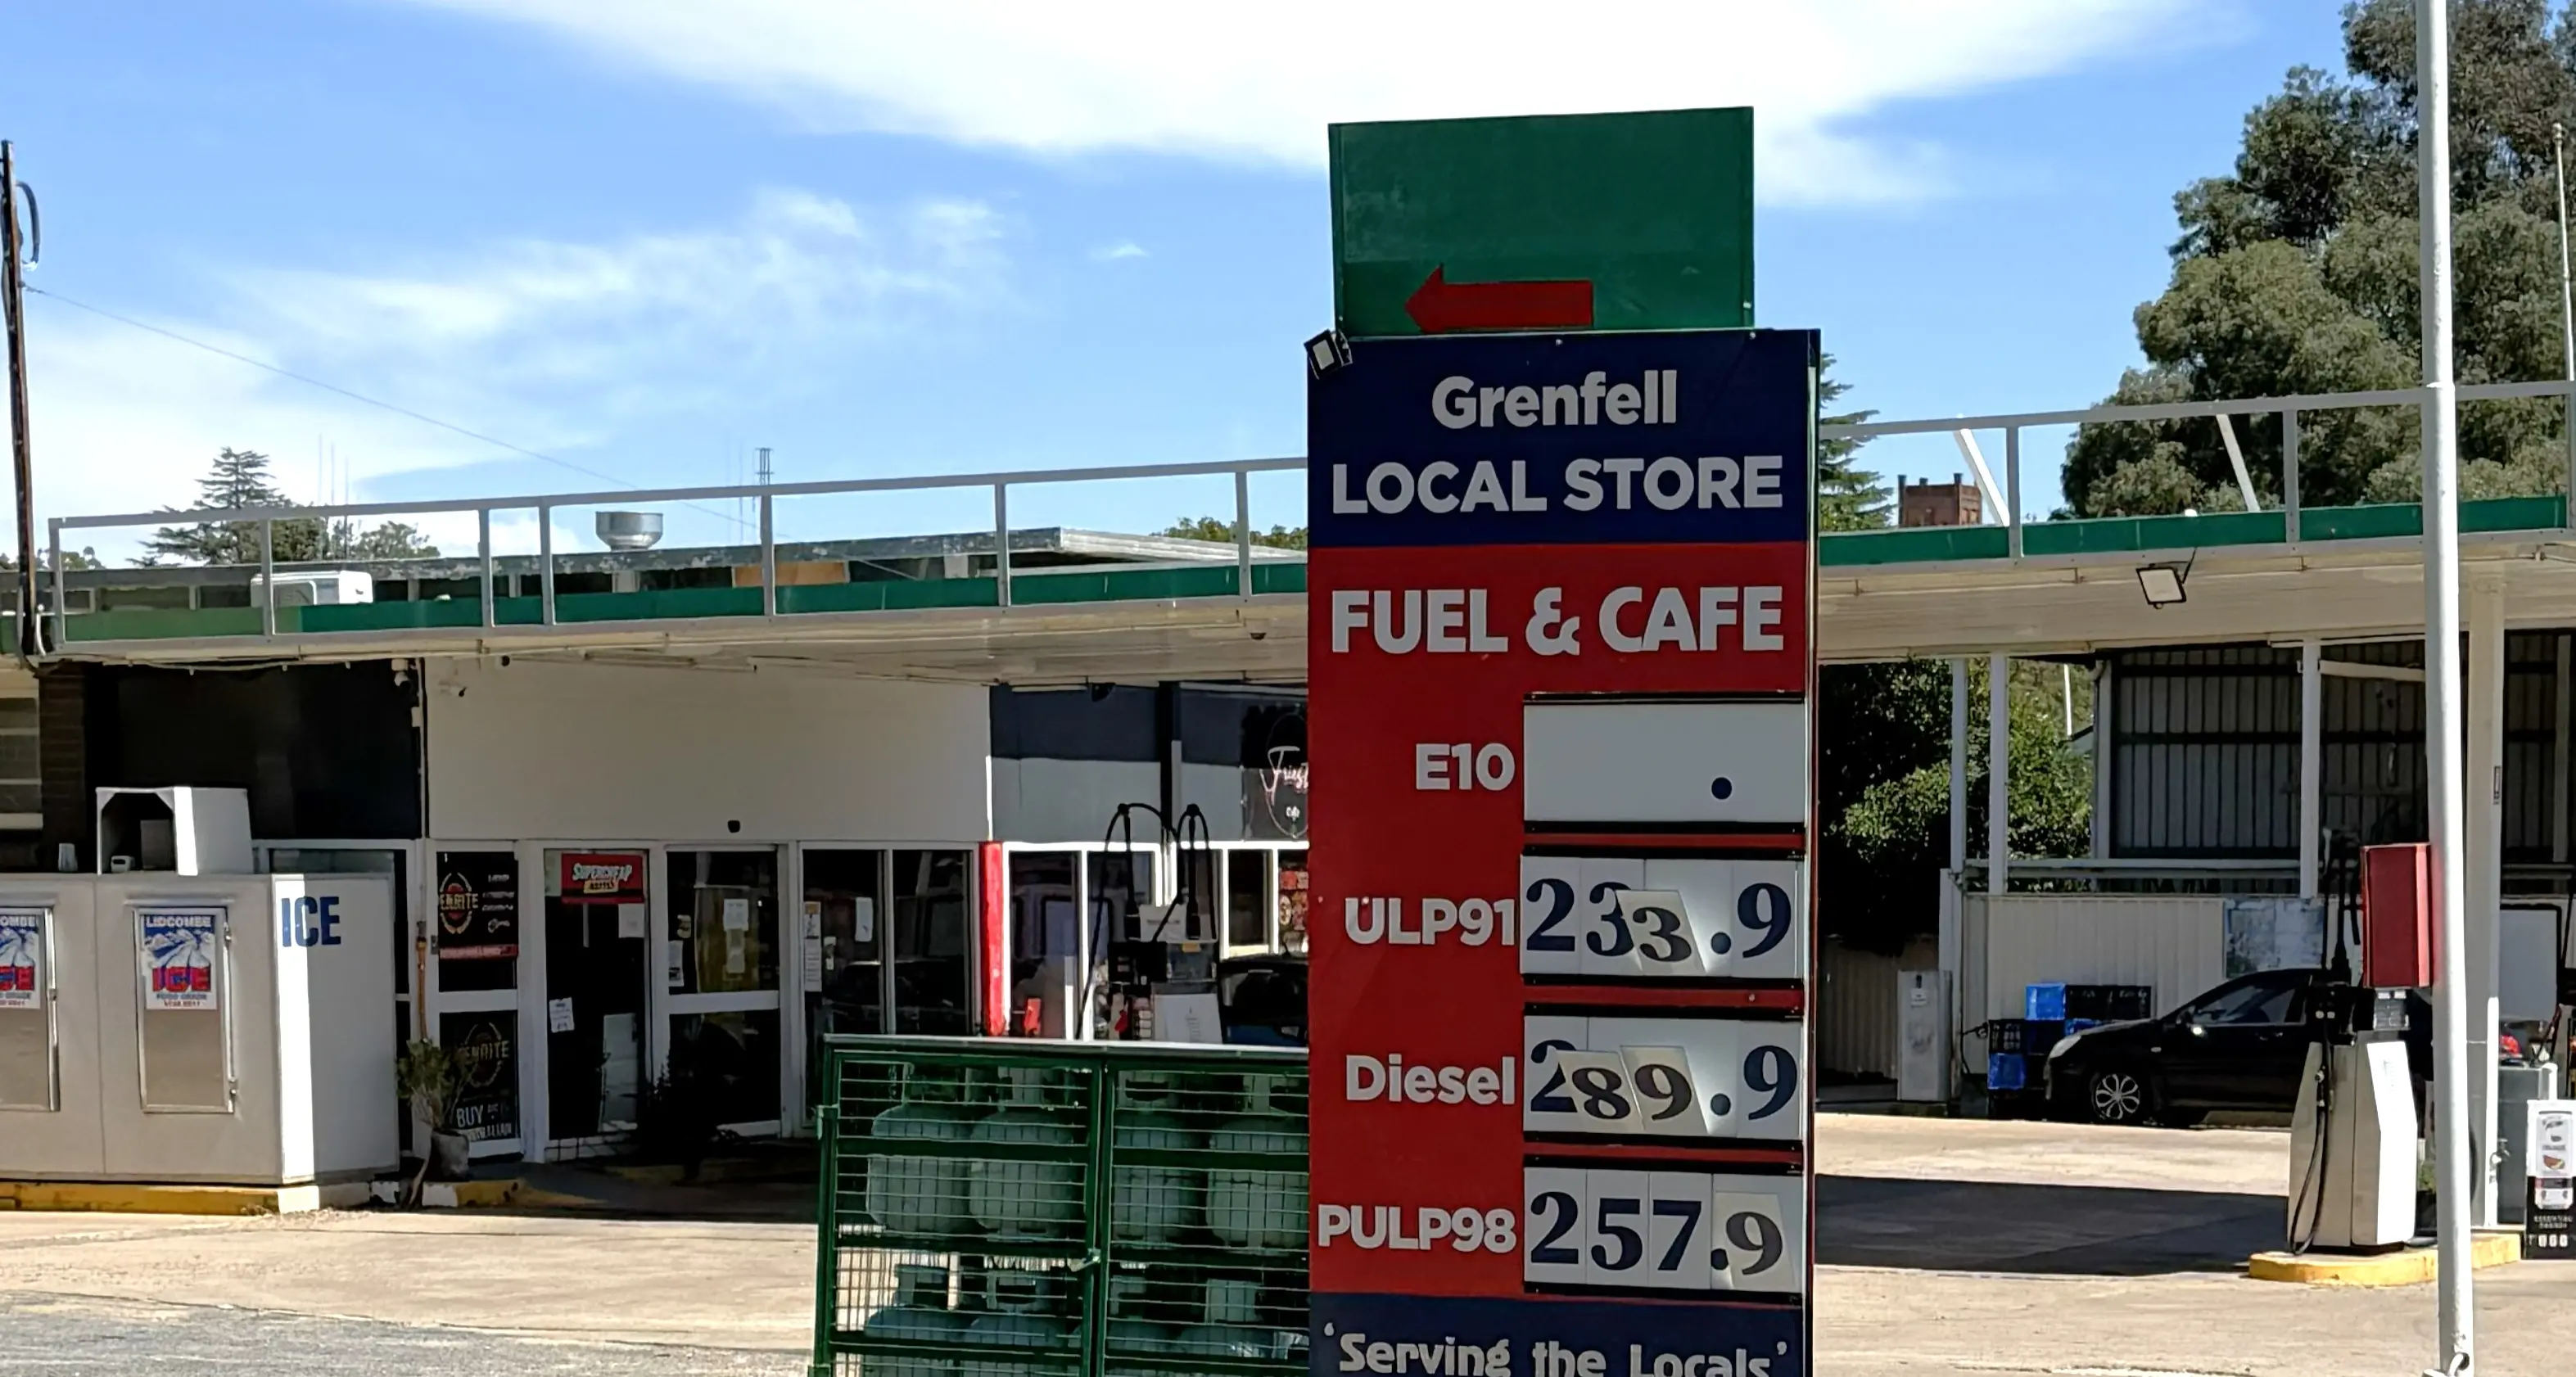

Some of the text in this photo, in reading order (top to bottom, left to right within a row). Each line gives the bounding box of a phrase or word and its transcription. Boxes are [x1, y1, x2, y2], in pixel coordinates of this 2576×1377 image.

[1431, 369, 1678, 429] Grenfell
[1331, 454, 1784, 515] LOCAL STORE
[1331, 586, 1784, 656] FUEL & CAFE
[1415, 743, 1516, 792] E10
[280, 896, 341, 947] ICE
[1344, 878, 1792, 962] ULP91 233.9
[151, 966, 211, 992] ICE
[1345, 1039, 1797, 1122] Diesel 289.9
[456, 1104, 484, 1128] BUY
[1317, 1191, 1783, 1276] PULP98 257.9
[1532, 1341, 1607, 1377] the
